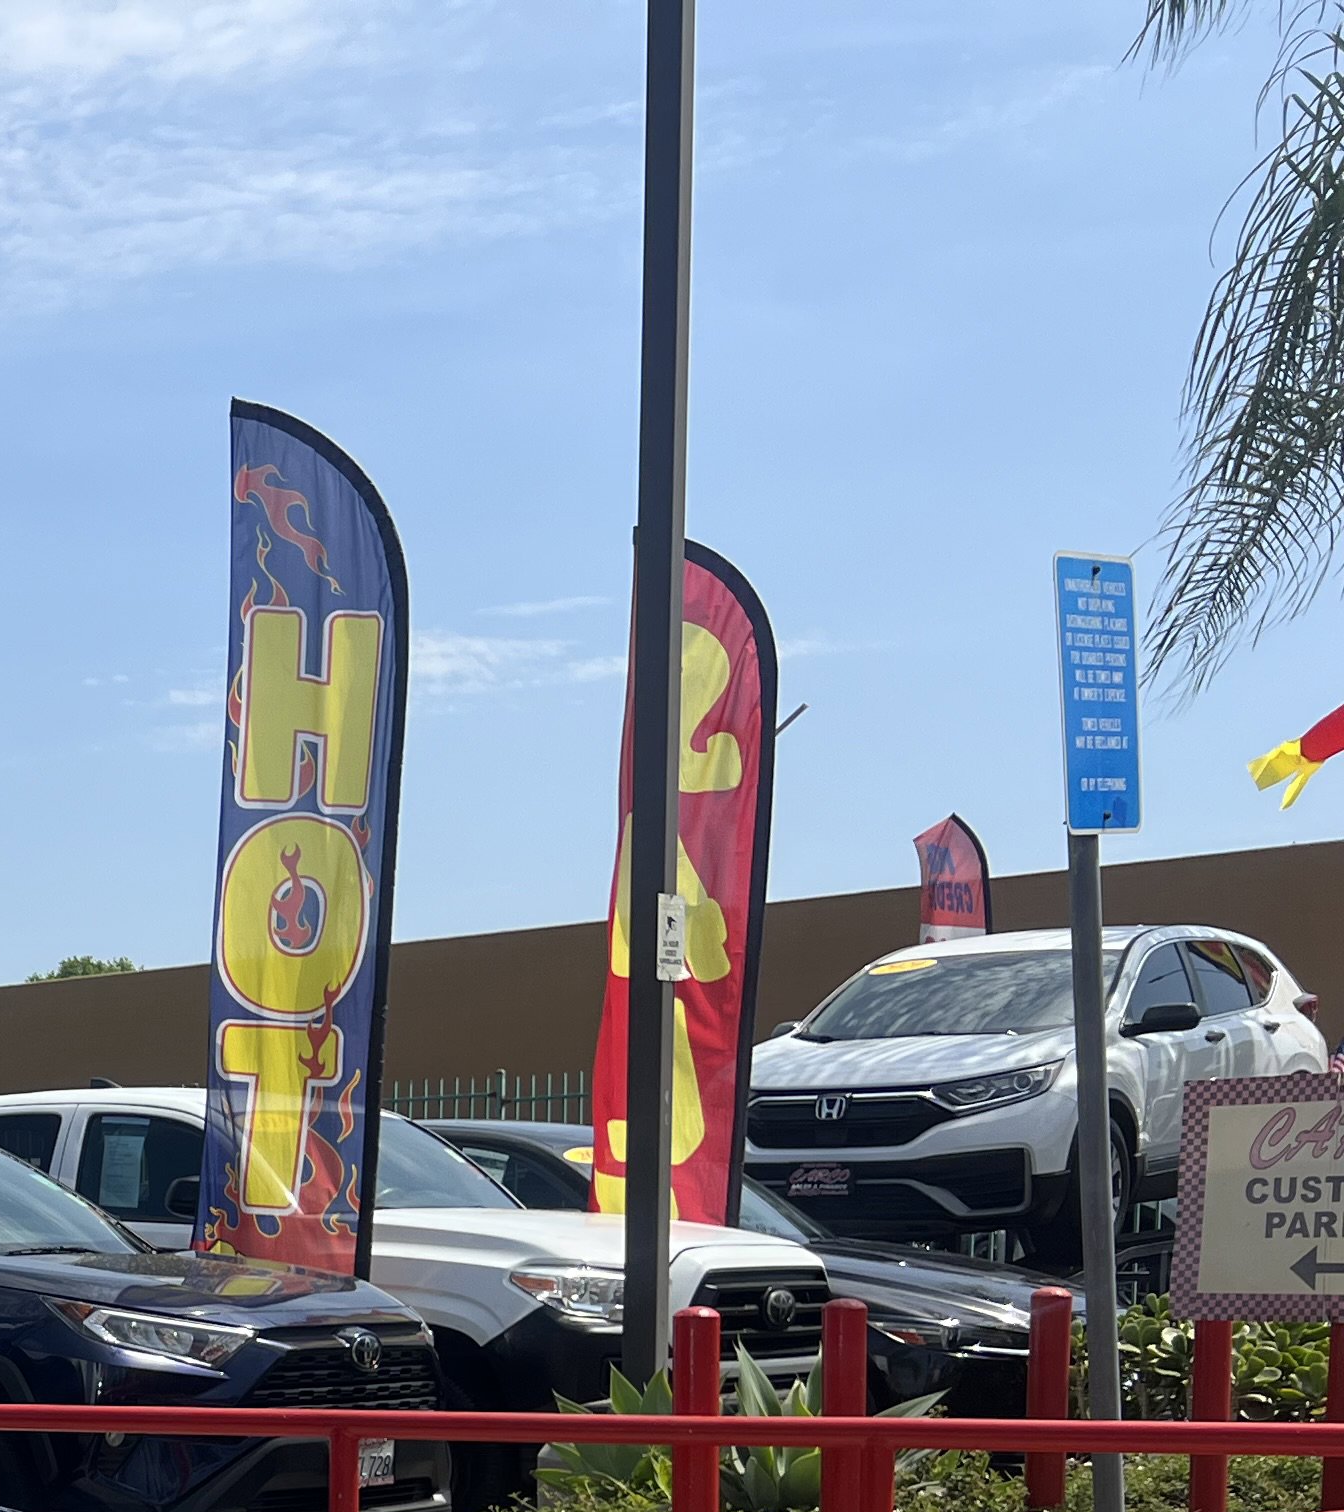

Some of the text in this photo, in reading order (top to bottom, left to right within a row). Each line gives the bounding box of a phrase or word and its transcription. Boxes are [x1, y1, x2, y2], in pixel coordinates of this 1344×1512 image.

[216, 602, 386, 1219] HOT
[1249, 1106, 1344, 1170] CA
[1264, 1210, 1344, 1239] PAR
